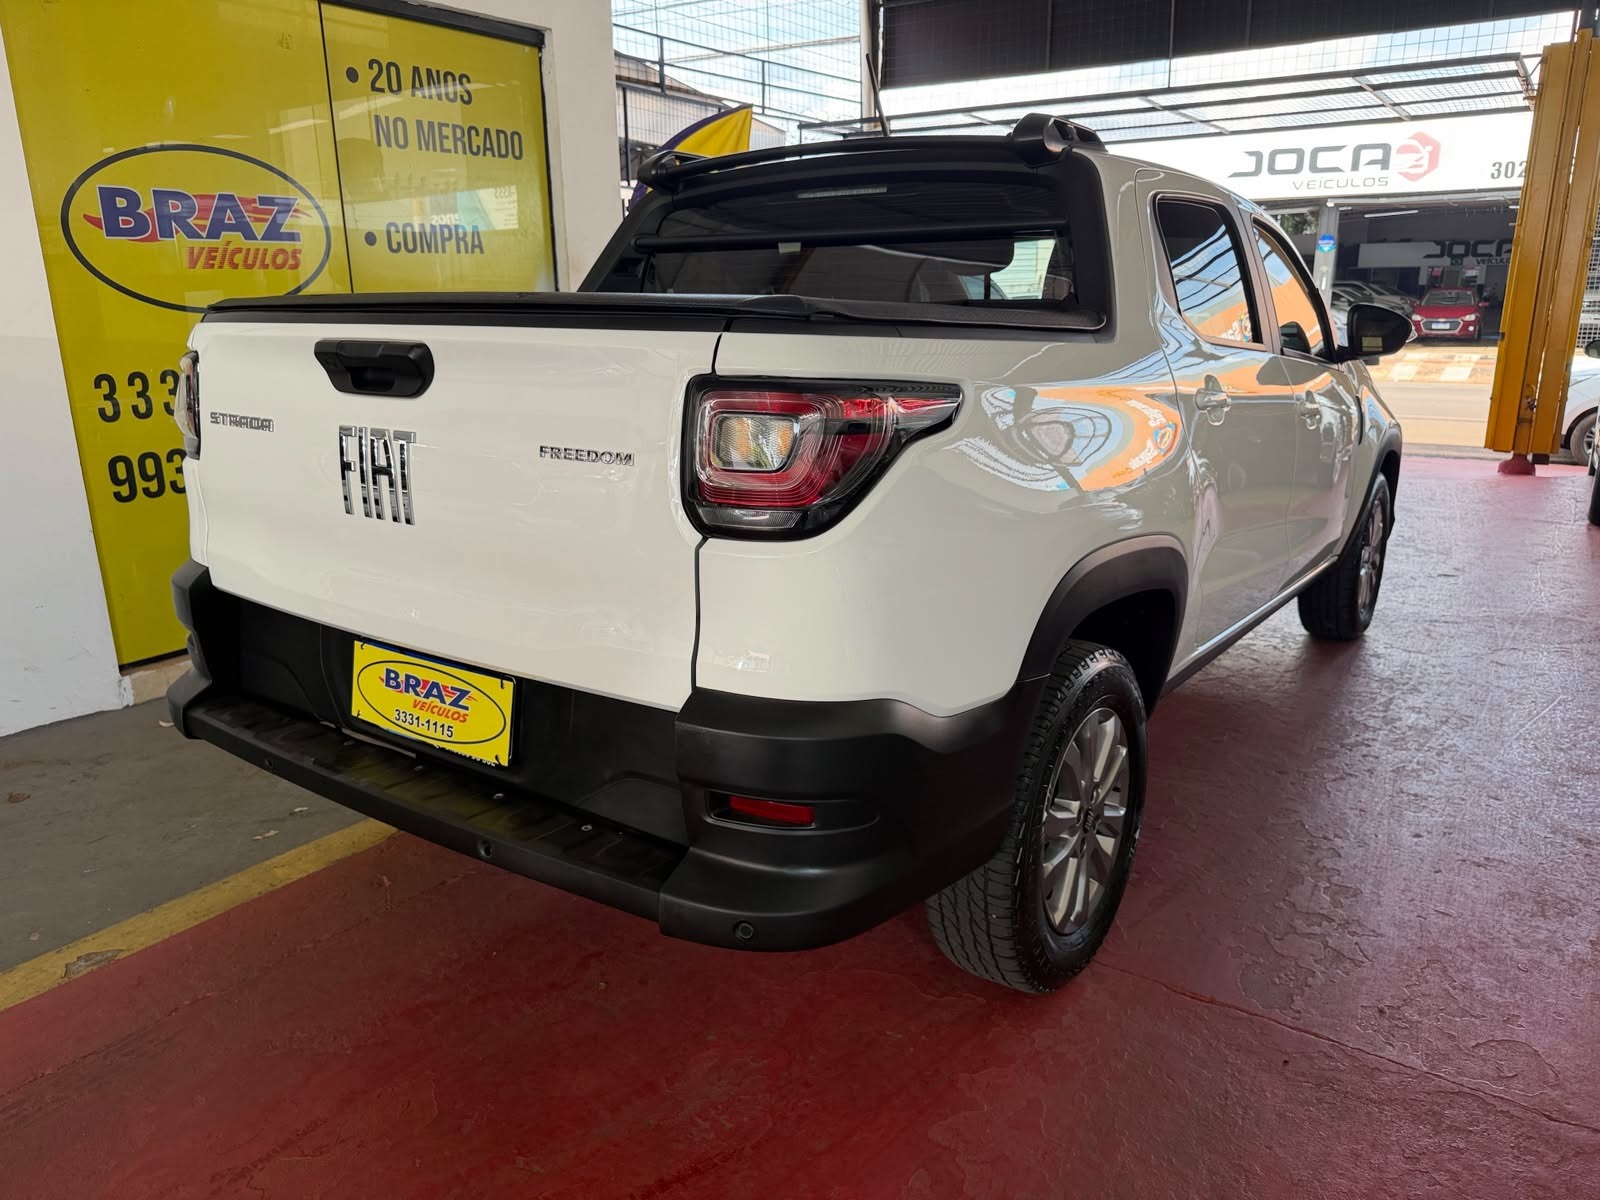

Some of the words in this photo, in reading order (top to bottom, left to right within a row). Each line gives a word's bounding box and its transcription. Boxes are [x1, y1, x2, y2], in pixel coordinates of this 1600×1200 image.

[368, 58, 402, 94] 20
[410, 65, 473, 105] ANOS
[373, 114, 409, 150] NO
[415, 119, 523, 160] MERCADO
[1227, 142, 1392, 178] JOCA
[97, 185, 302, 243] BRAZ
[187, 241, 302, 270] VEÍCULOS
[385, 222, 485, 255] COMPRA
[210, 411, 275, 433] STRADA
[539, 445, 635, 466] FREEDOM
[108, 448, 187, 503] 993
[339, 424, 417, 526] FIAT
[384, 667, 472, 711] BRAZ
[395, 709, 454, 738] 3331-1115
[412, 699, 469, 724] VEÍCULOS
